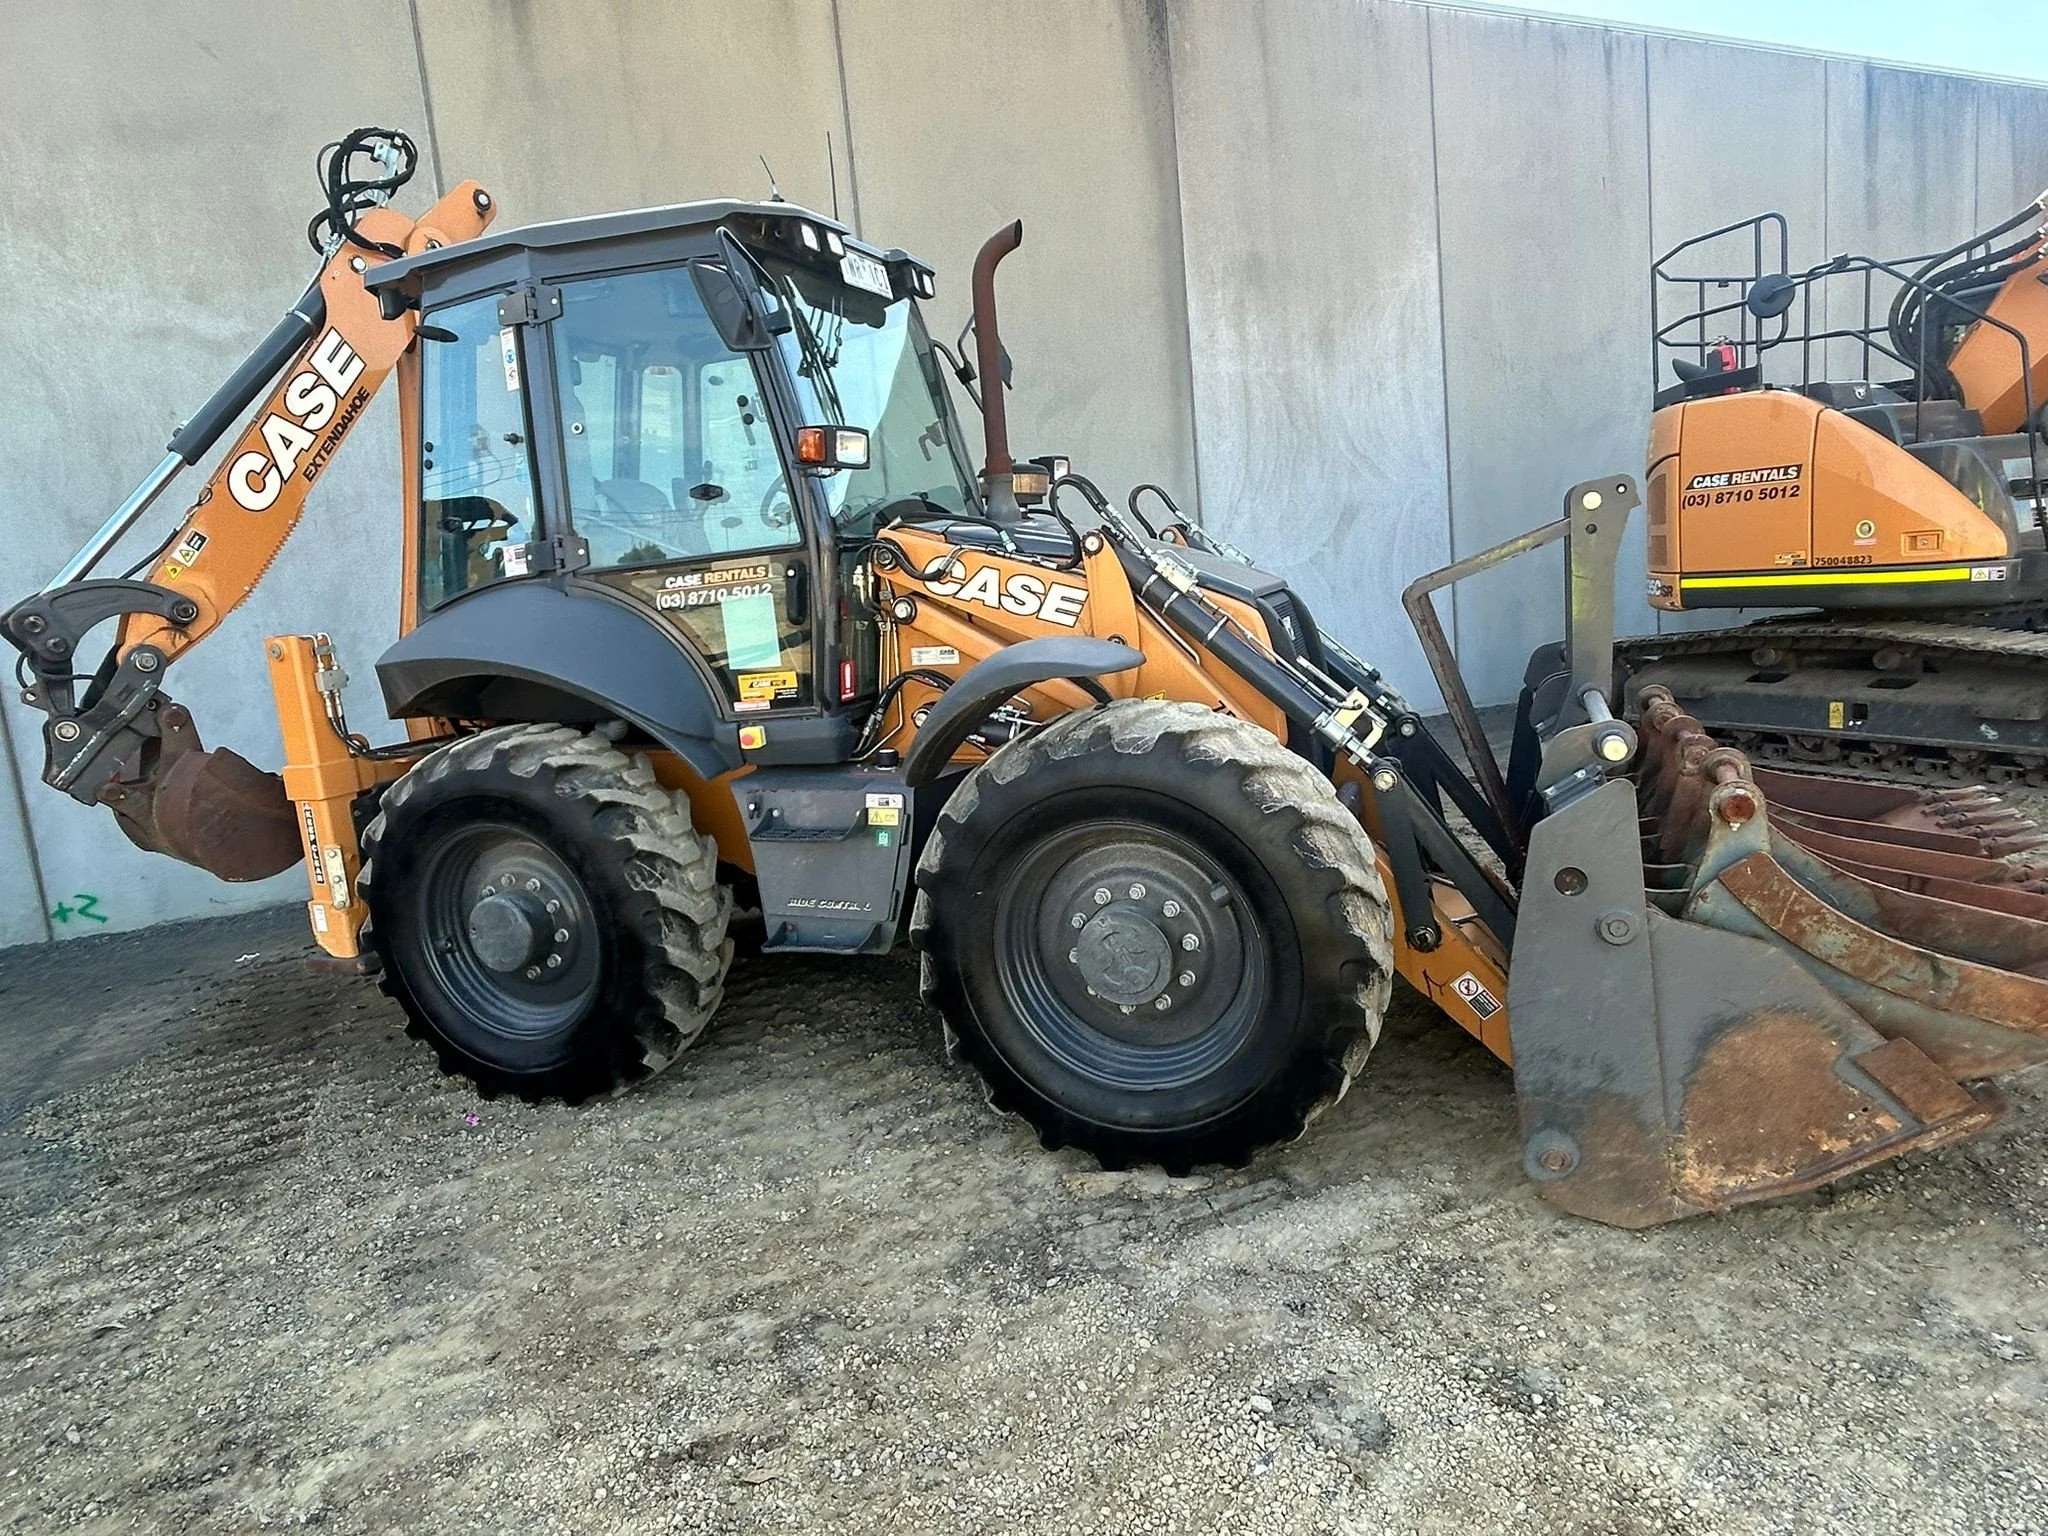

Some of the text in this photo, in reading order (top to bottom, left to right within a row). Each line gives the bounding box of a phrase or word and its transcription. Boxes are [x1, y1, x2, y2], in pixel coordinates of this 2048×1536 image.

[227, 326, 367, 512] CASE
[302, 386, 370, 482] EXTENDAHOE
[1693, 466, 1799, 489] CASE RENTALS
[1682, 485, 1800, 510] (03) 8710 5012
[1815, 555, 1873, 566] 750048823
[665, 566, 766, 588] CASE RENTALS
[656, 583, 772, 611] (03) 8710 5012
[923, 555, 1090, 629] CASE
